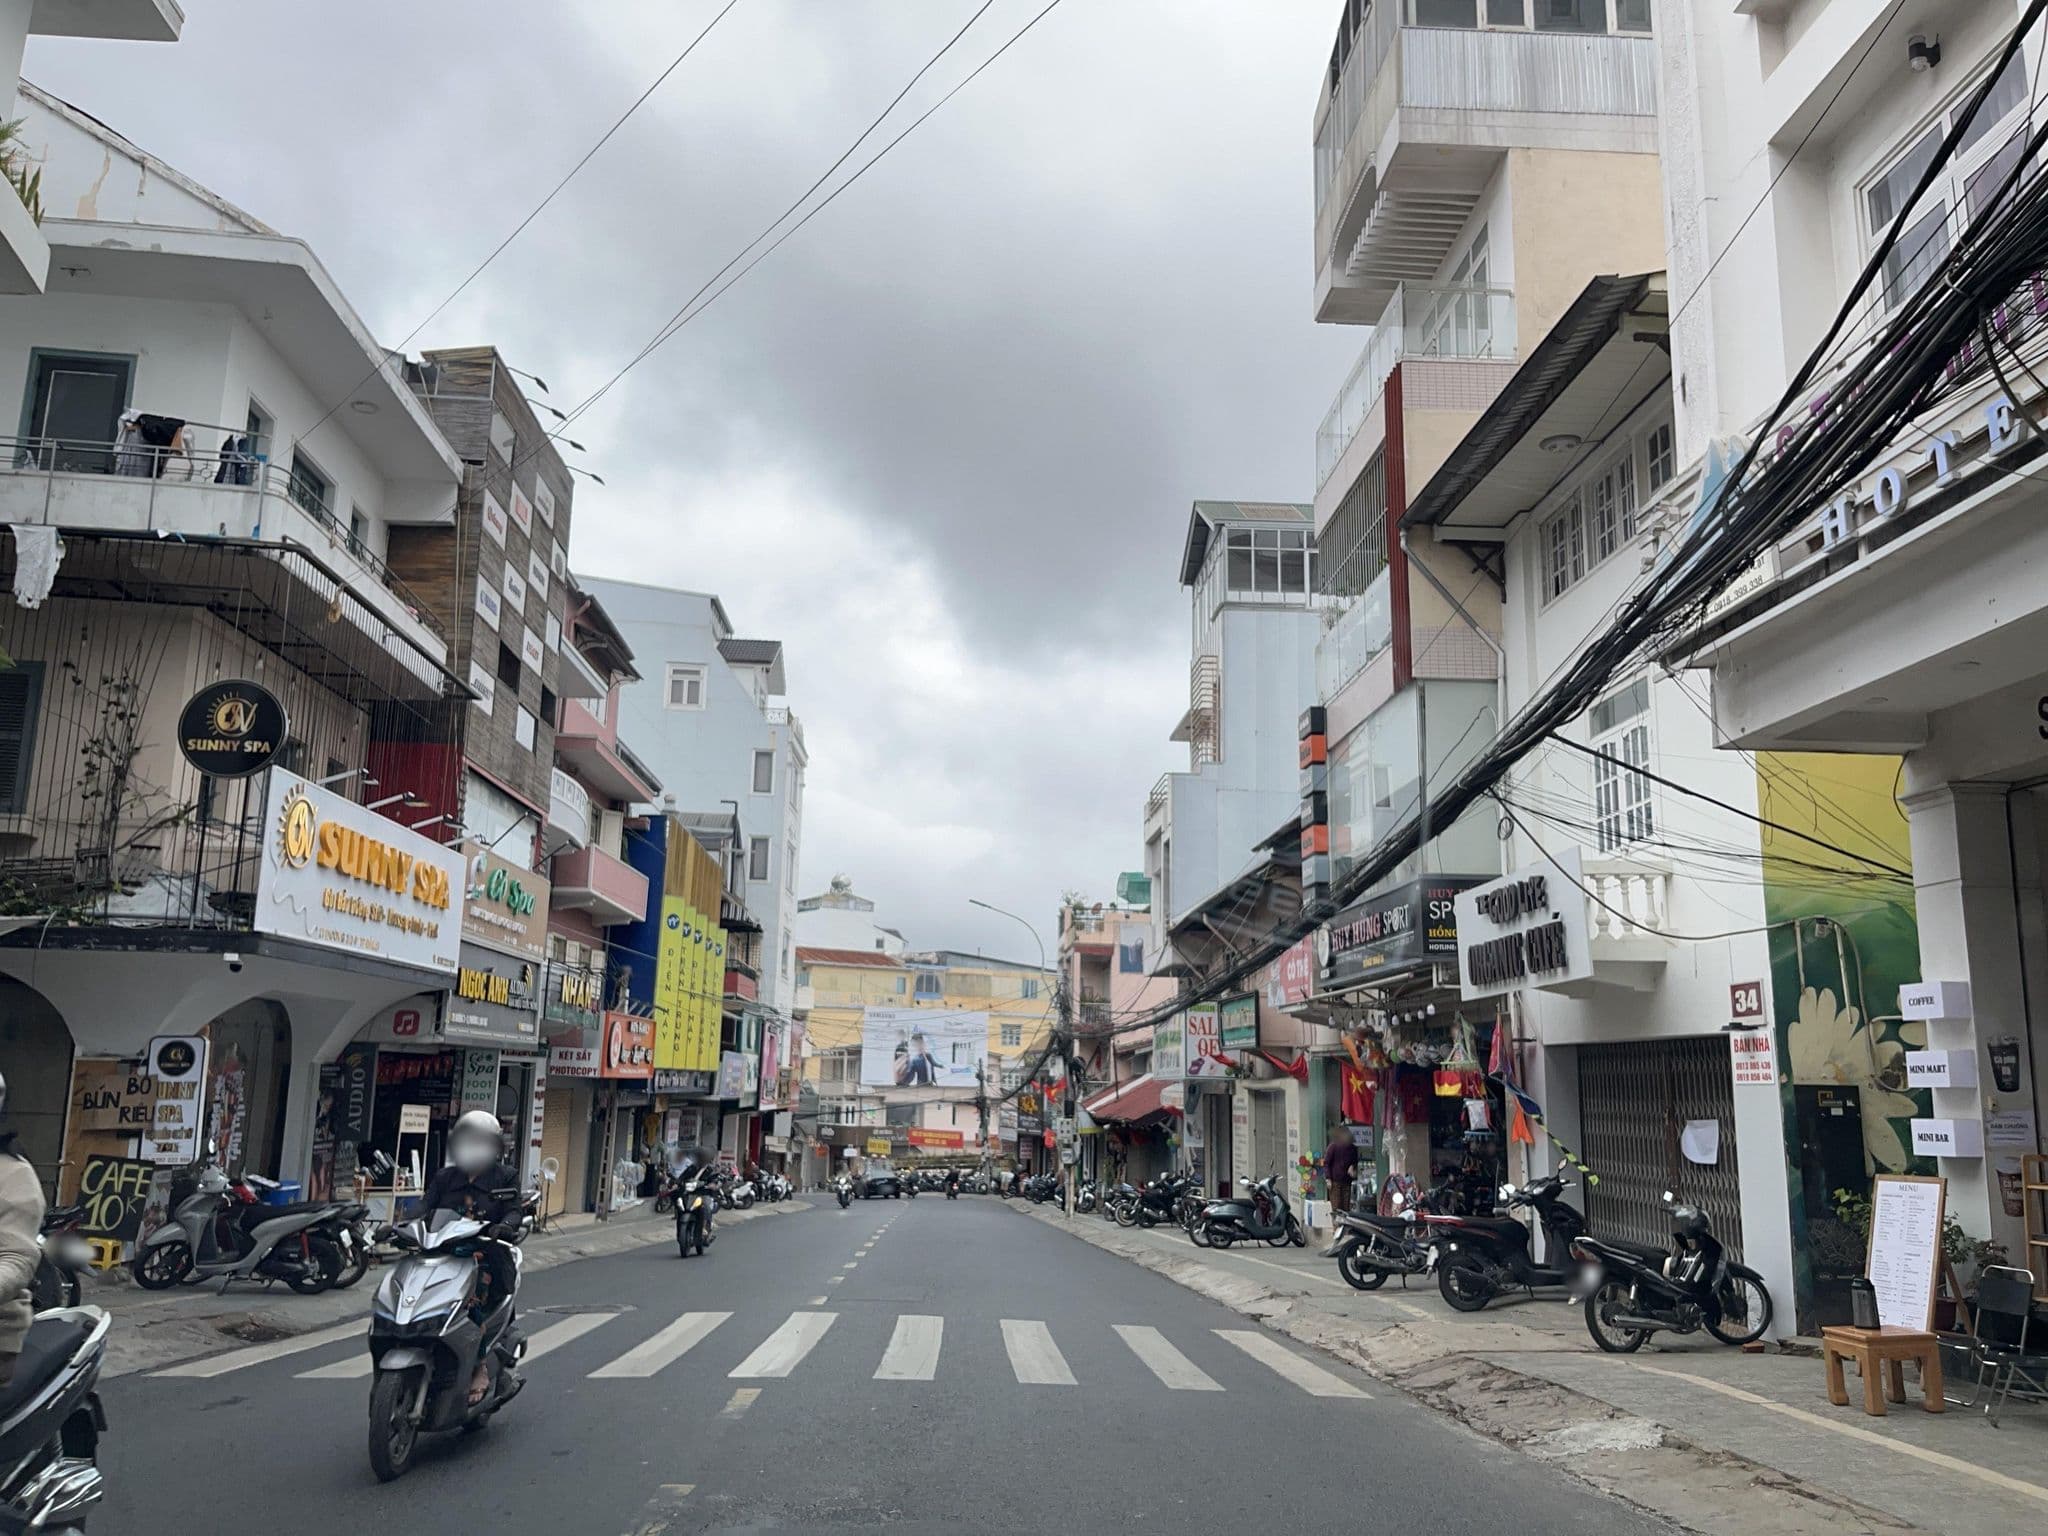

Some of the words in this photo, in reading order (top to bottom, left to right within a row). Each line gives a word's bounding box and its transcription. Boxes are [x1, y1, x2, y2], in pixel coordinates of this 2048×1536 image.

[1820, 390, 2034, 553] HOTE
[187, 739, 240, 752] SUNNY
[243, 741, 271, 753] SPA
[317, 821, 413, 895] SUNNY
[412, 859, 449, 910] SPA
[1428, 888, 1453, 898] HUY
[1429, 900, 1456, 920] SP
[1331, 924, 1350, 952] HUY
[1383, 904, 1409, 934] SPORT
[1467, 932, 1525, 986] ORGANIC
[488, 975, 509, 1005] ANH
[1735, 988, 1759, 1013] 34
[1908, 996, 1935, 1006] COFFEE
[1188, 1015, 1218, 1036] SAL
[467, 1062, 494, 1076] Spa
[550, 1065, 598, 1076] PHOTOCOPY
[1909, 1063, 1925, 1074] MINI
[1926, 1063, 1947, 1074] MART
[157, 1081, 198, 1099] UNNY
[466, 1080, 492, 1089] FOOT
[348, 1067, 366, 1132] AUDIO
[465, 1092, 491, 1101] BODY
[158, 1104, 184, 1123] SPA
[1917, 1131, 1934, 1143] MINI
[1935, 1131, 1949, 1143] BAR
[81, 1160, 153, 1199] CAFE
[1899, 1183, 1919, 1193] MENU
